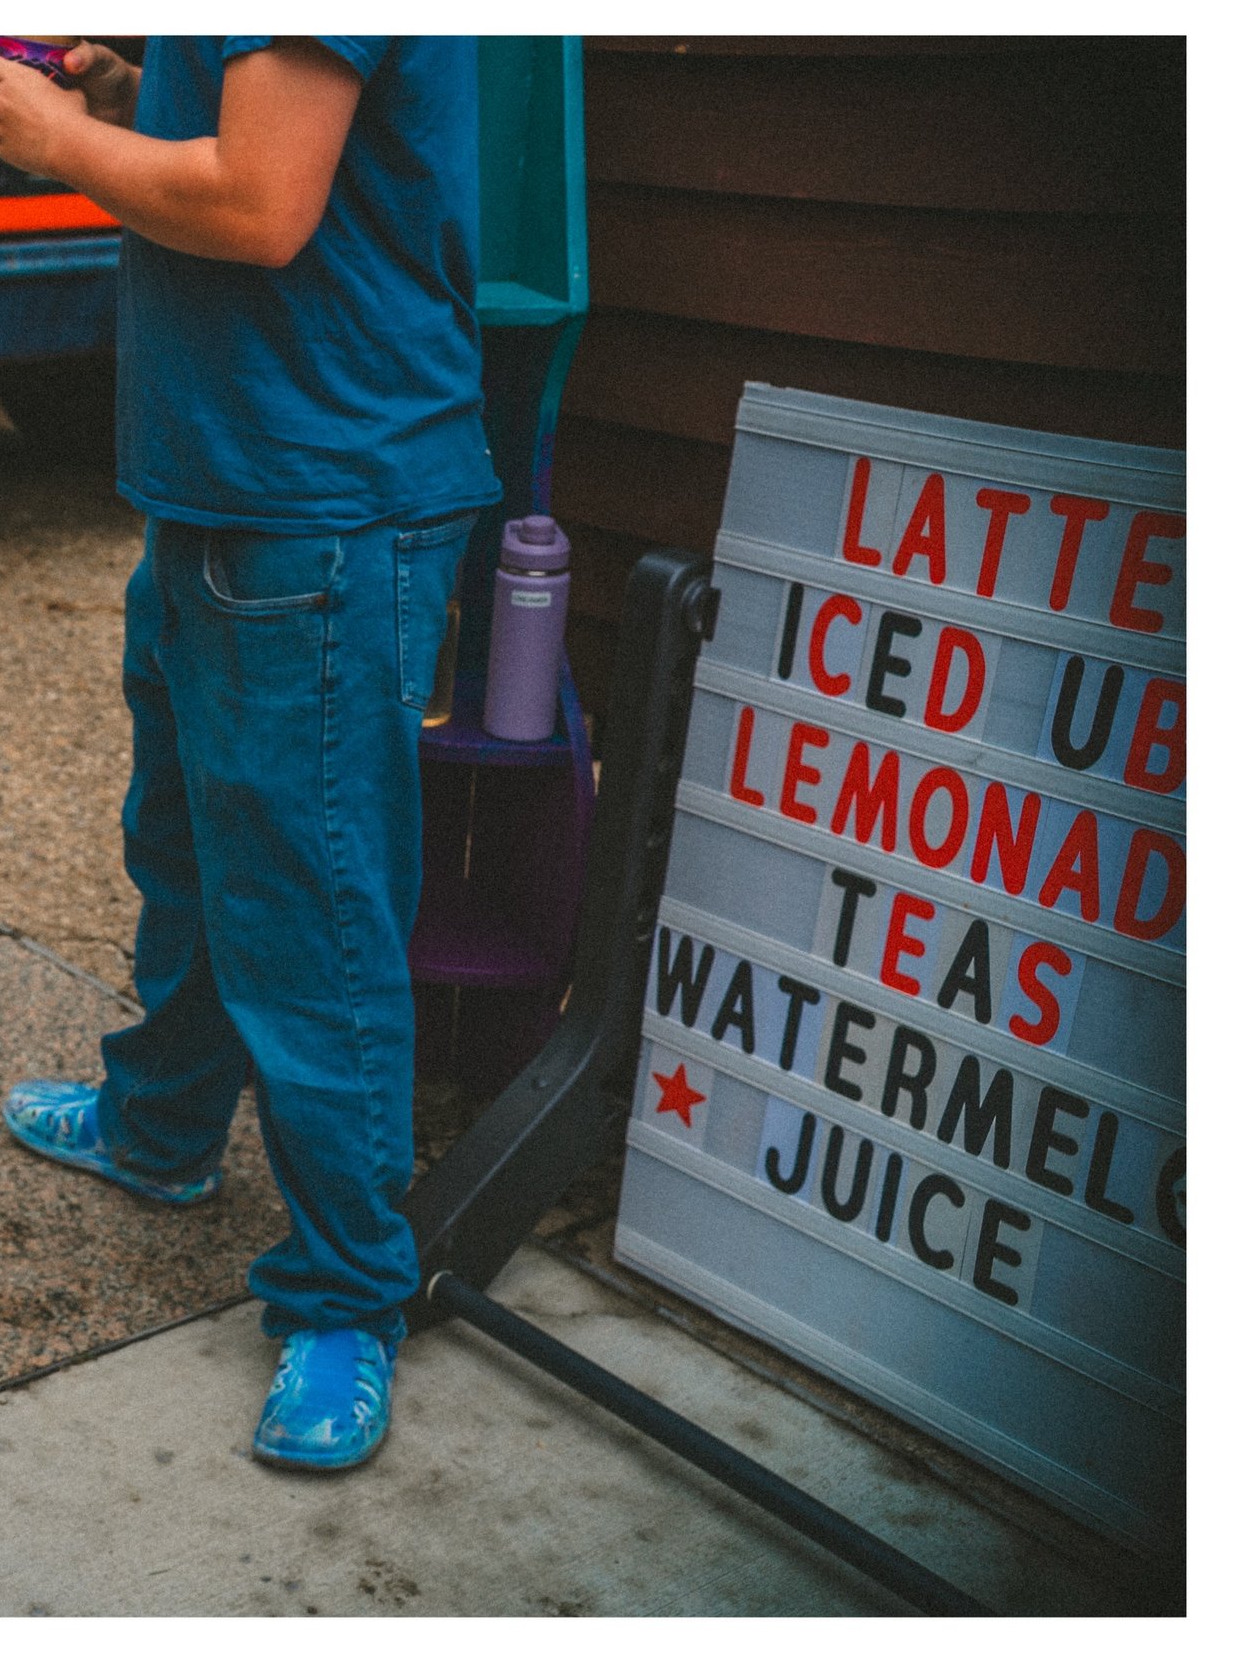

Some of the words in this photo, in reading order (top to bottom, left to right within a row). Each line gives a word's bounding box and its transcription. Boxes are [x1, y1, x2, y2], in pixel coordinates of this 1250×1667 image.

[842, 455, 1187, 633] LATTE
[777, 580, 987, 733] ICED
[1051, 654, 1187, 794] UB
[729, 706, 1187, 940] LEMONAD
[831, 867, 1073, 1046] TEAS
[764, 1110, 1033, 1307] JUICE
